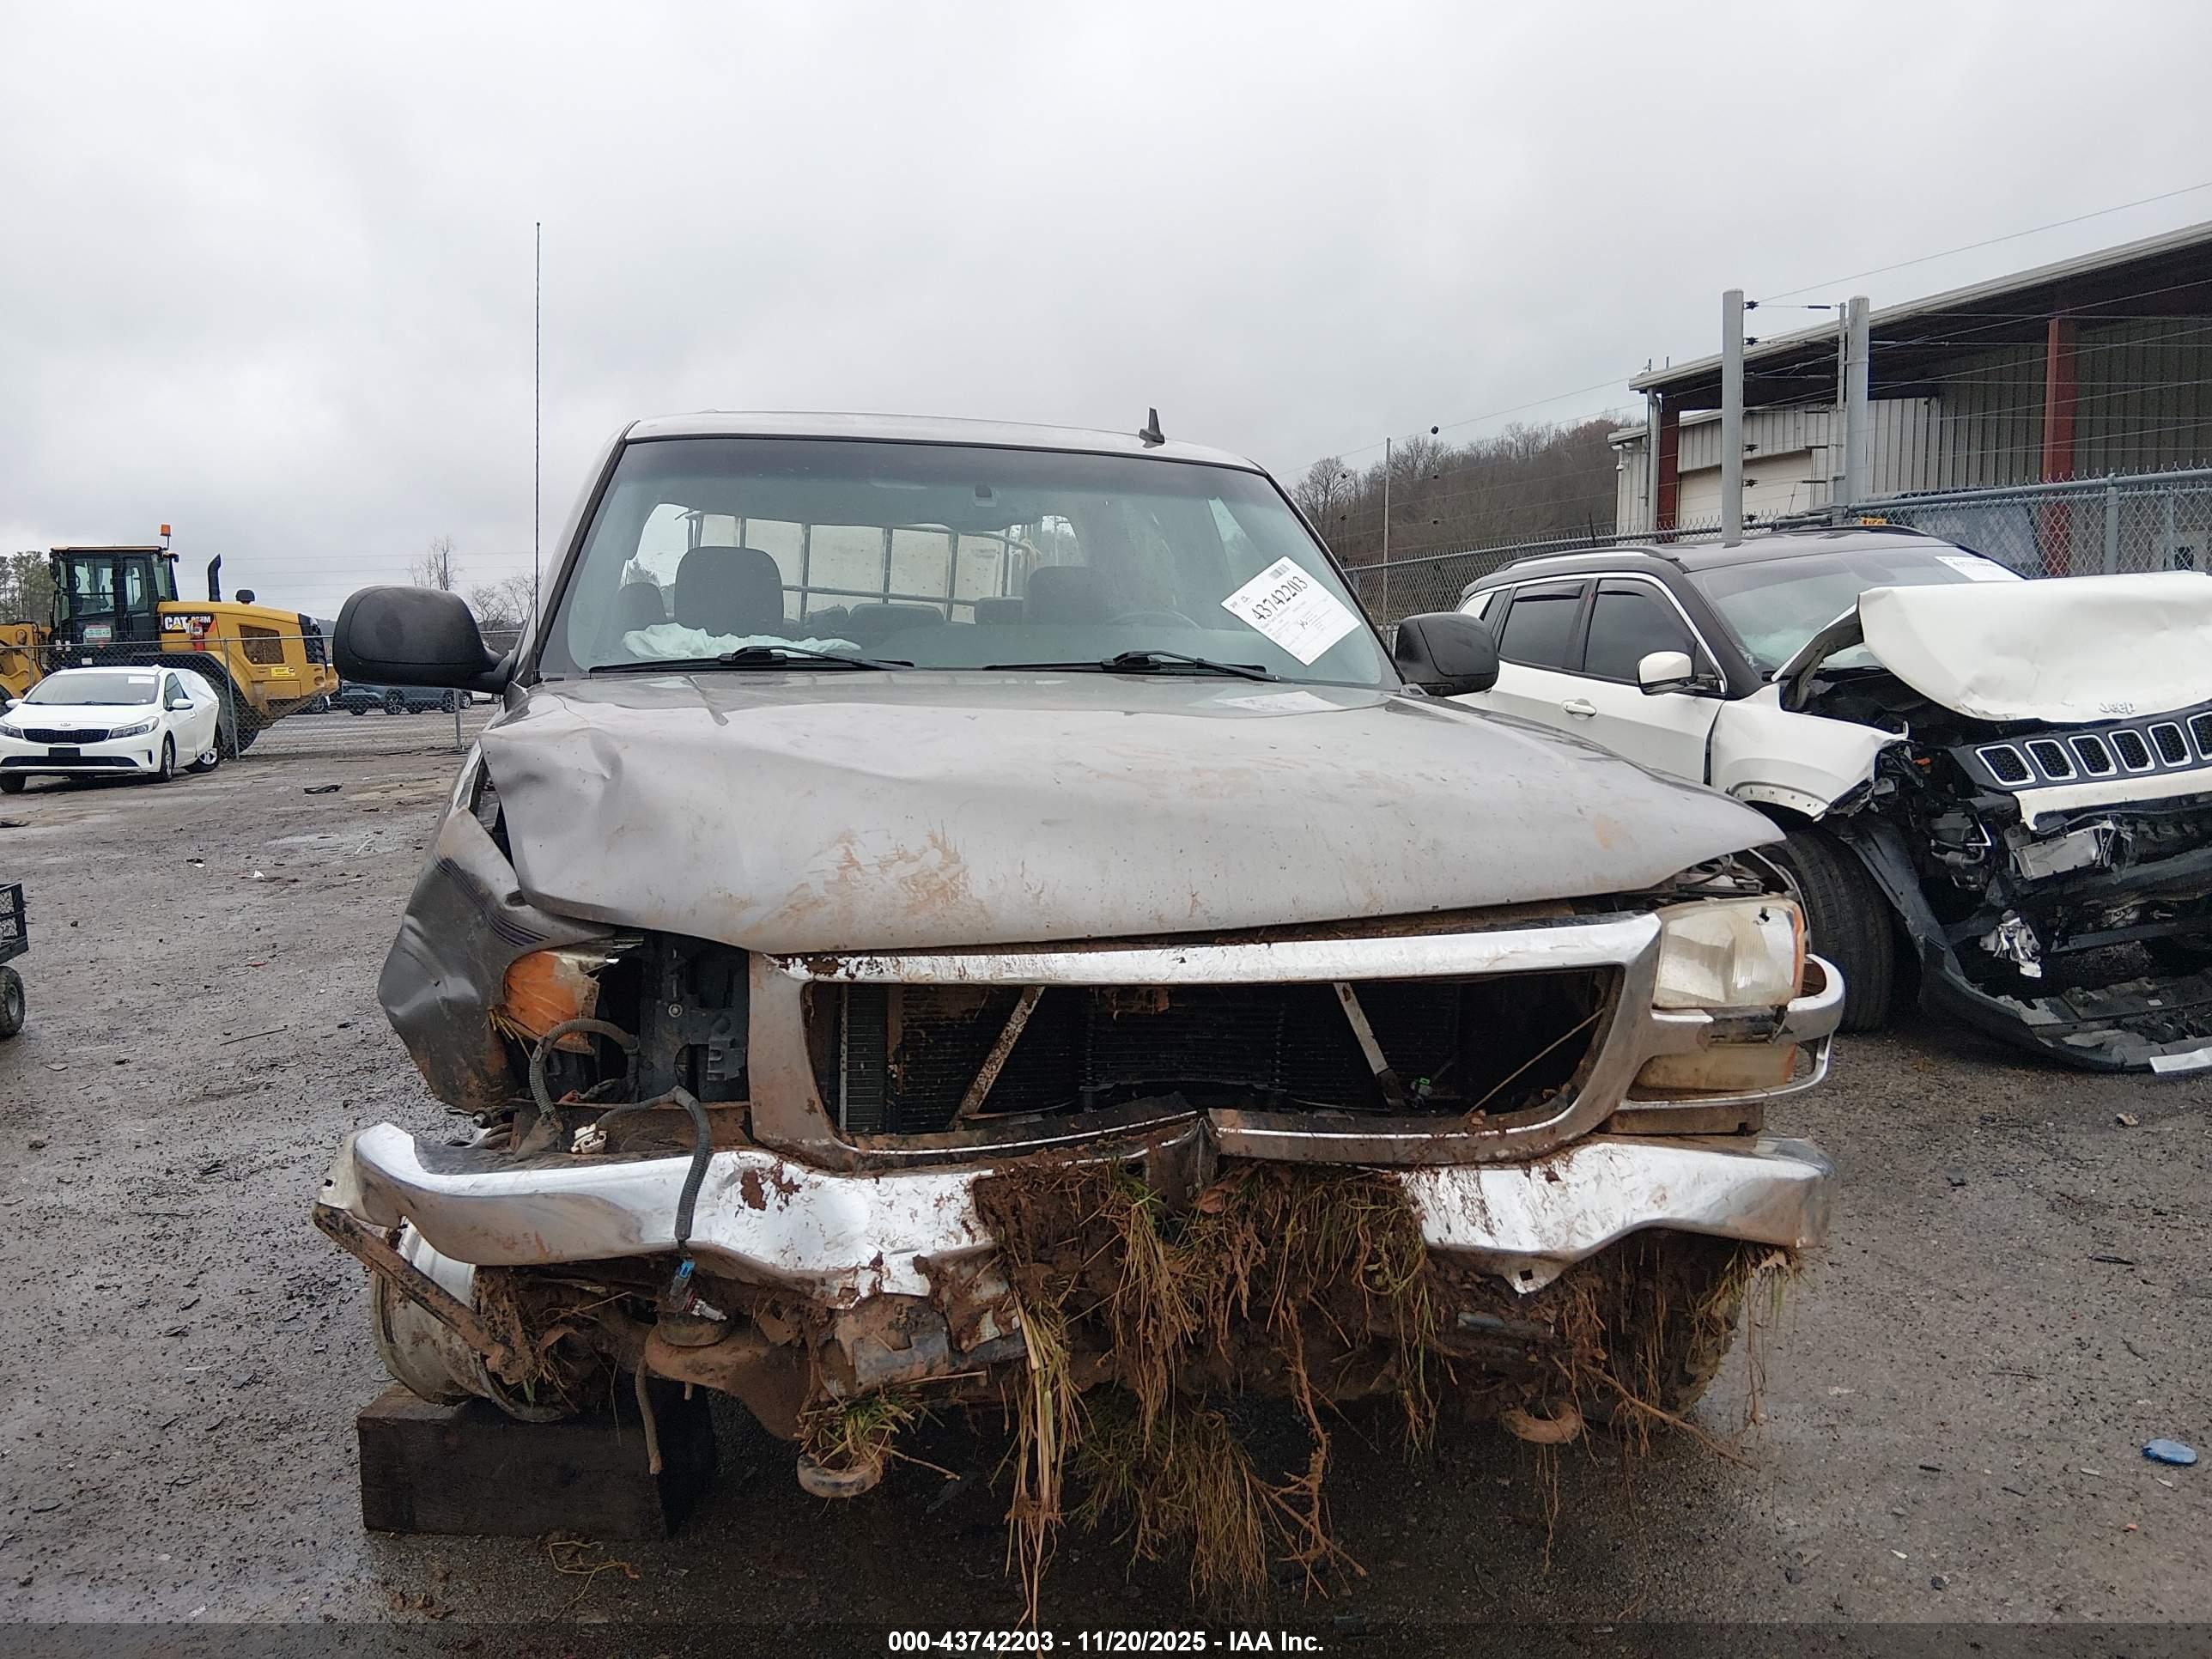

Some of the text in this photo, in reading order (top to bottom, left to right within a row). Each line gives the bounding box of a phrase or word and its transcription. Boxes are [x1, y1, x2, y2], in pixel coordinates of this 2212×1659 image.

[1251, 575, 1308, 620] 43742203
[164, 617, 188, 630] CAT
[2098, 701, 2136, 715] Jeep
